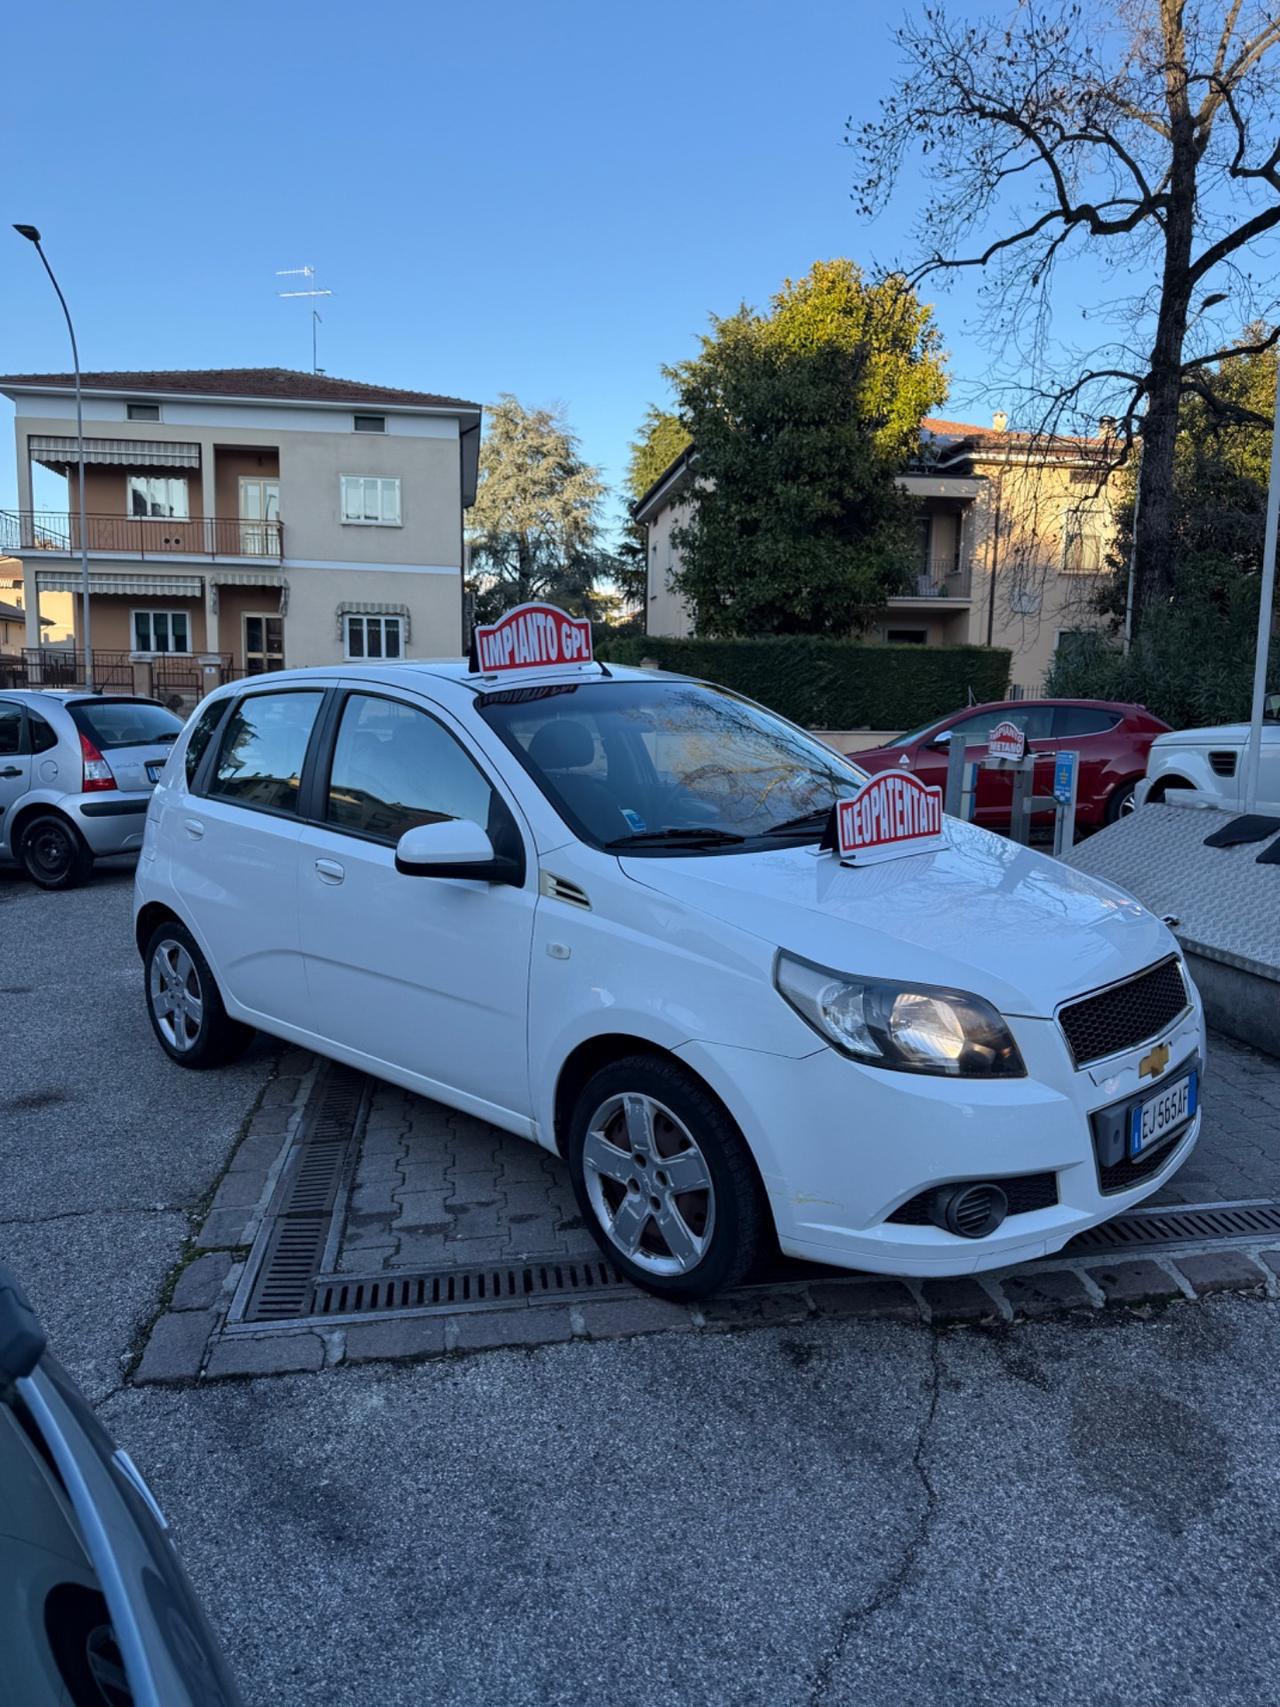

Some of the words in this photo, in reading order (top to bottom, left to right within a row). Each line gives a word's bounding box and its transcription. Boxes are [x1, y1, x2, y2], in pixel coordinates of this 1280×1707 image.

[482, 612, 558, 667] IMPIANTO
[562, 622, 589, 659] GPL
[990, 741, 1022, 754] METANO
[843, 777, 939, 847] NEOPATENTATI
